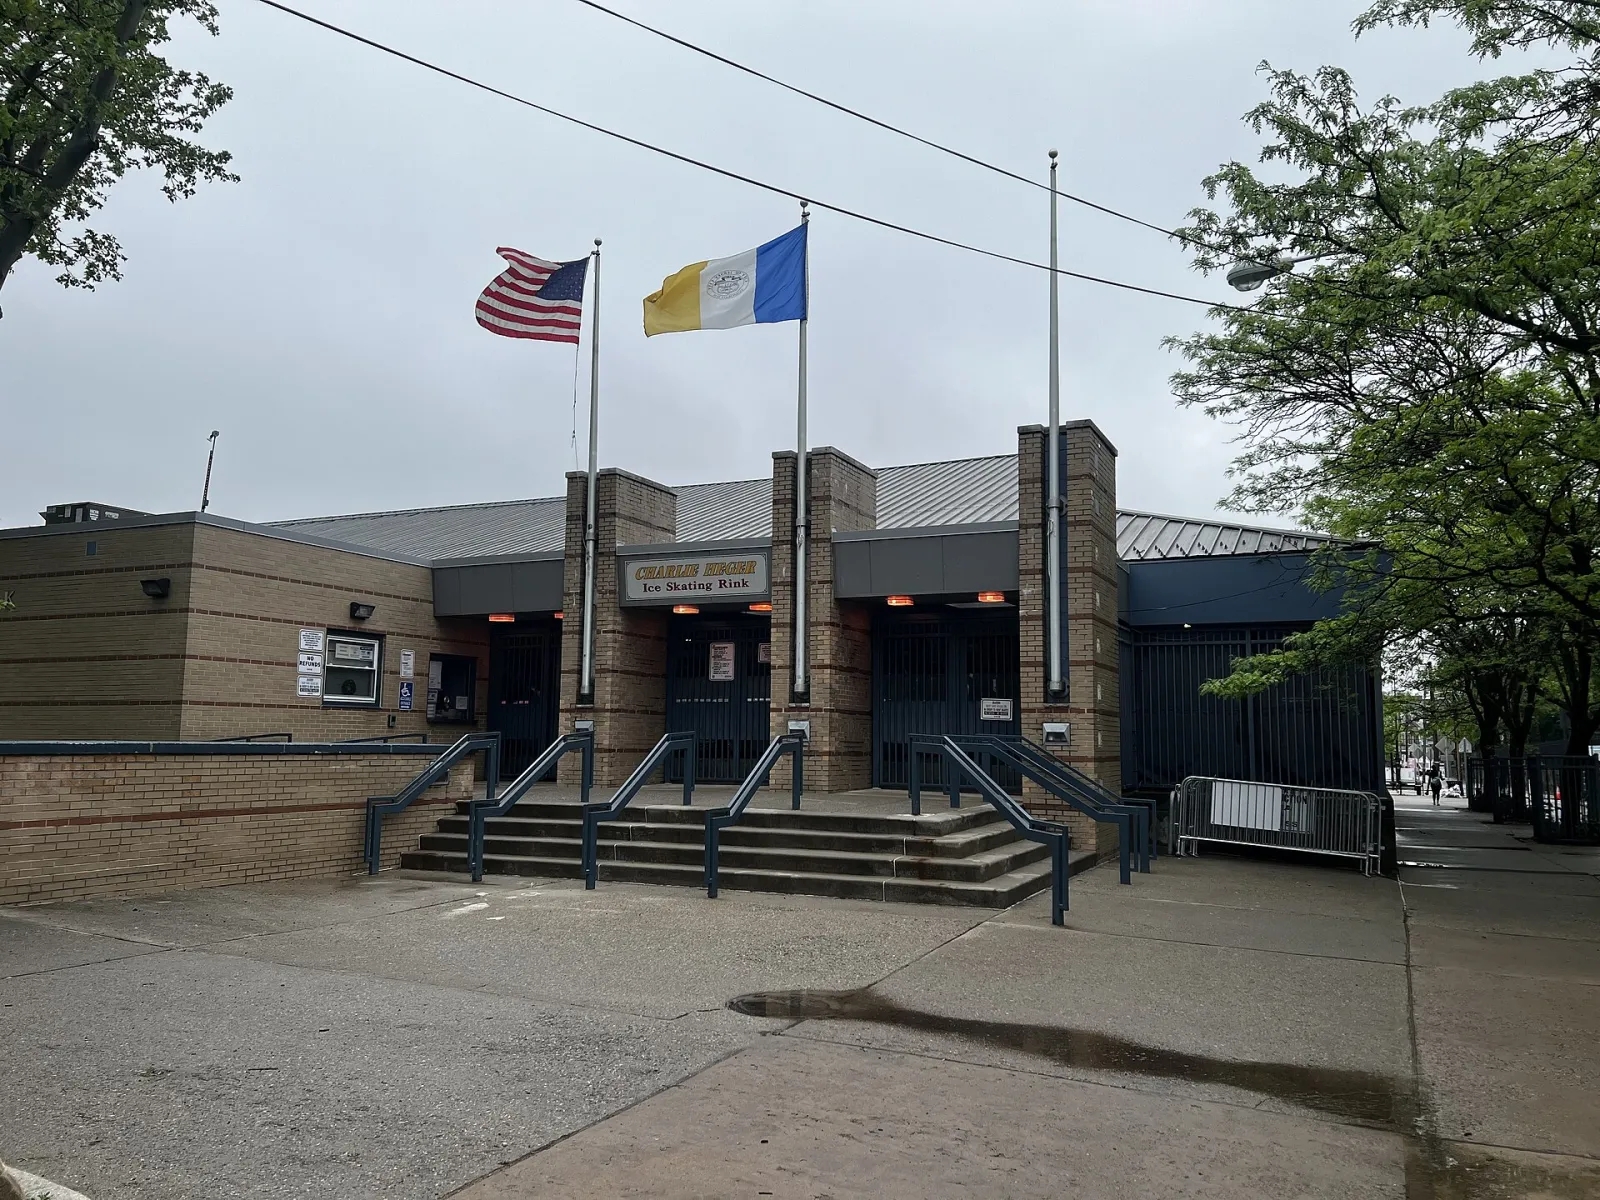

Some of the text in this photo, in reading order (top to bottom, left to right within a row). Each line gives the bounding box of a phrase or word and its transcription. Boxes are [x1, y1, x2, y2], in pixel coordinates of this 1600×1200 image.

[635, 564, 699, 580] CHARLIE
[643, 579, 749, 592] Ice Skating Rink
[299, 660, 321, 668] REFUNDS
